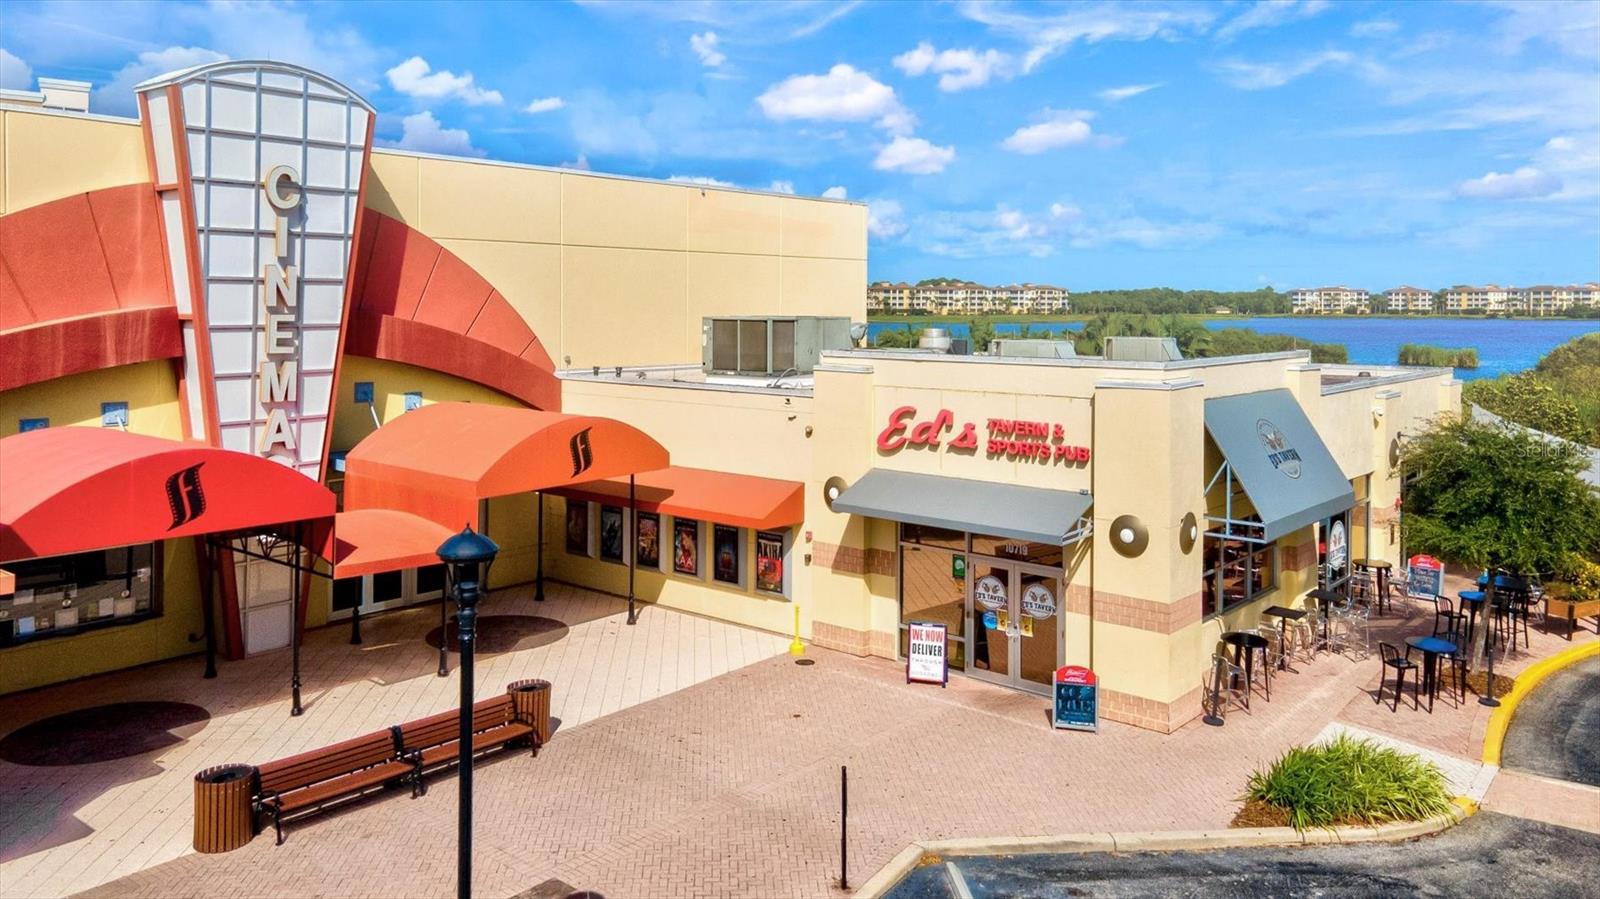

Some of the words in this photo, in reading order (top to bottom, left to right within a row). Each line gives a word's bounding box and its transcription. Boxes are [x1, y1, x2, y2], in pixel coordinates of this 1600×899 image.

[259, 165, 300, 467] CINEMA
[877, 406, 978, 450] Ed's
[986, 418, 1049, 437] TAVERN
[1052, 423, 1065, 439] &
[986, 439, 1050, 458] SPORTS
[1054, 445, 1090, 463] PUB
[1005, 543, 1029, 556] 10719
[911, 628, 924, 641] WE
[925, 629, 944, 643] NOW
[911, 643, 943, 657] DELIVER
